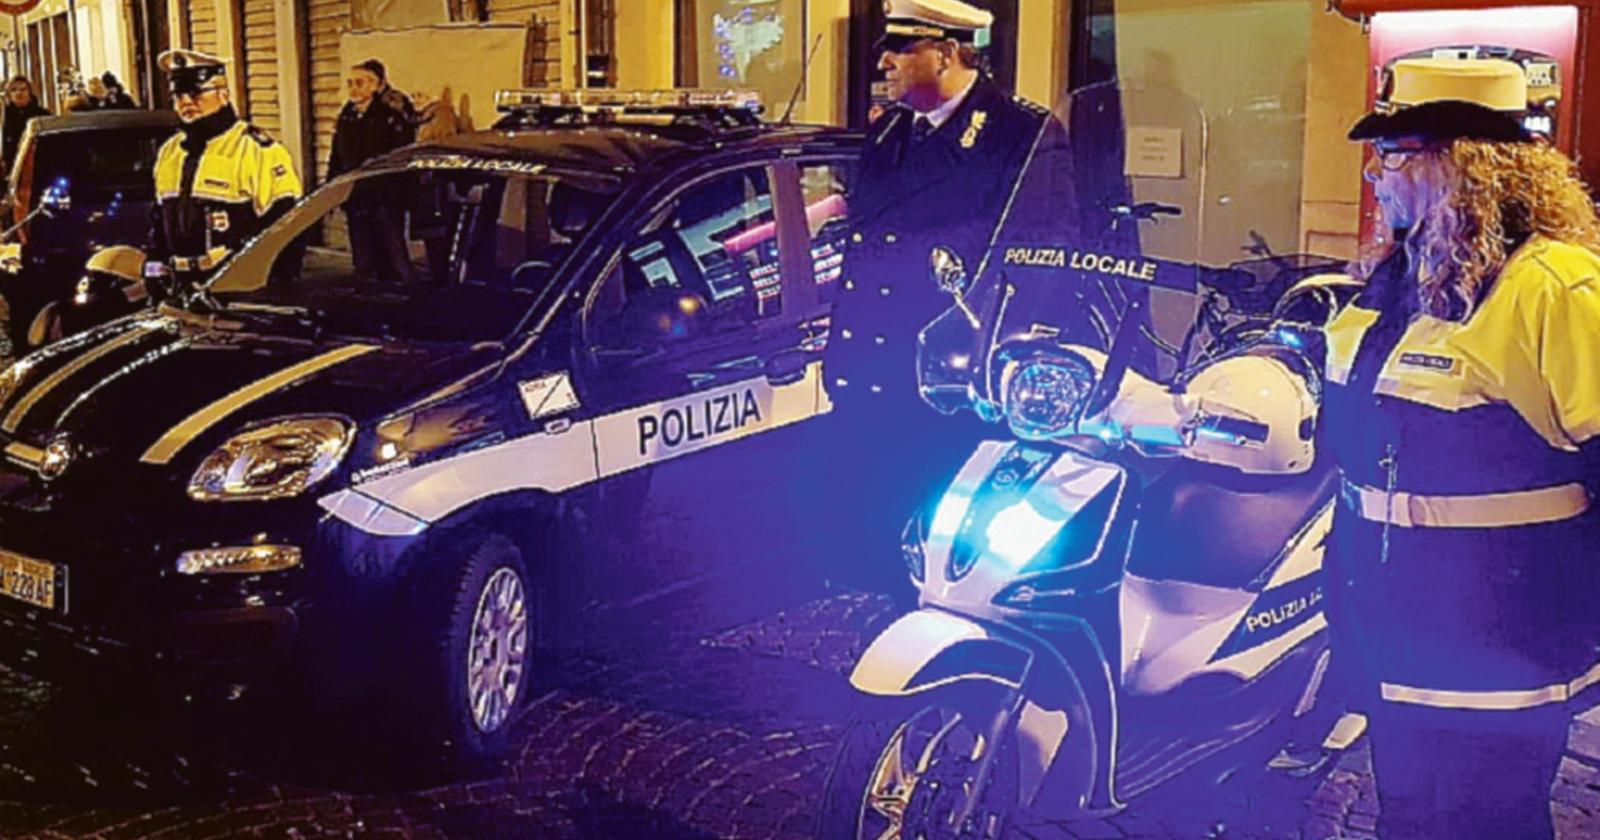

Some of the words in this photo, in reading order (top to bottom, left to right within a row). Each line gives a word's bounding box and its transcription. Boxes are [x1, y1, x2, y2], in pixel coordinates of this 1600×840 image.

[407, 157, 473, 169] POLIZIA
[474, 159, 547, 174] LOCALE
[1004, 248, 1065, 267] POLIZIA
[1070, 252, 1157, 280] LOCALE
[638, 388, 761, 455] POLIZIA
[1246, 597, 1306, 632] POLIZIA
